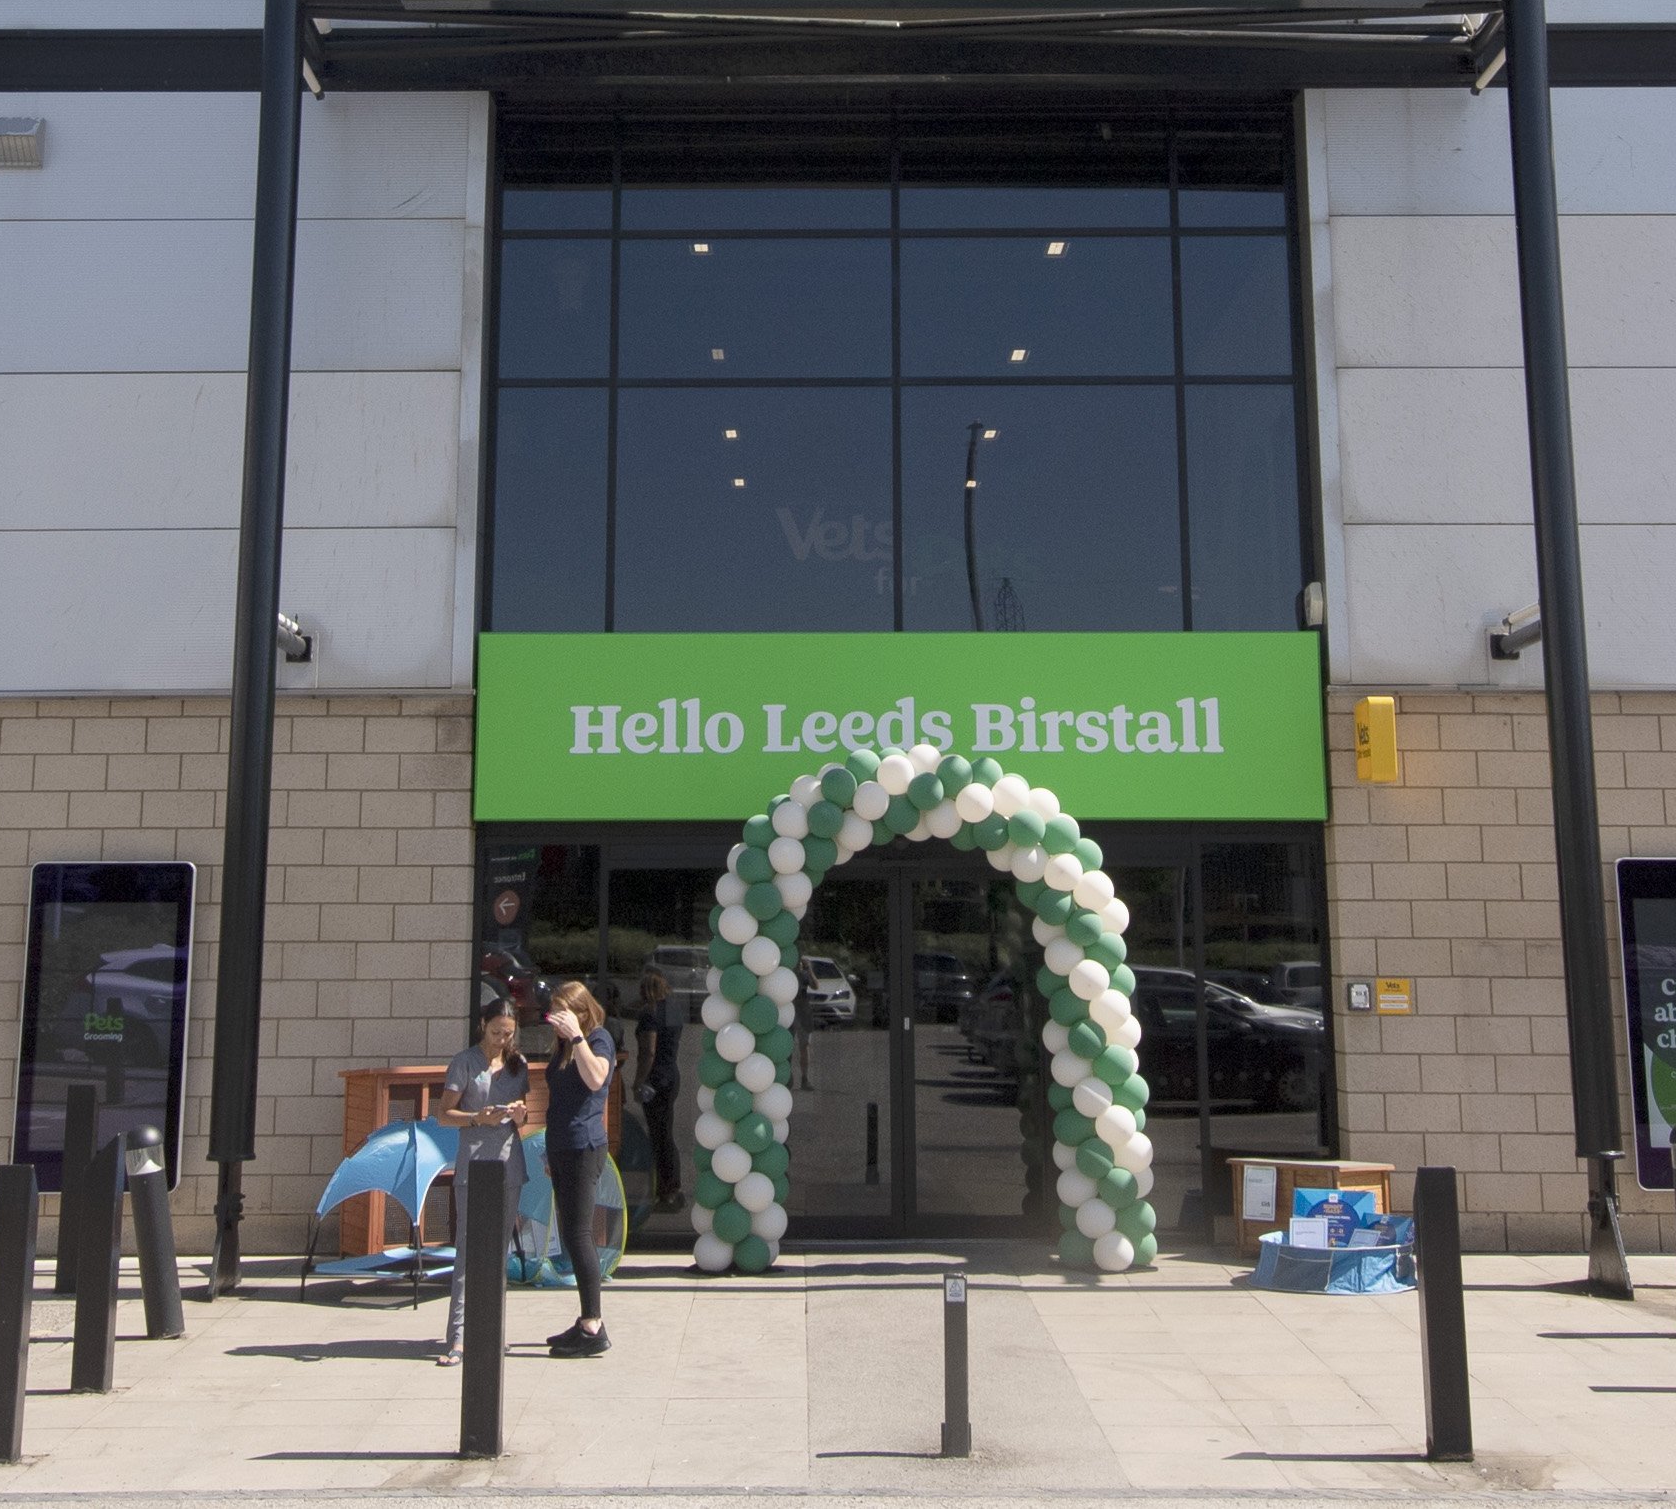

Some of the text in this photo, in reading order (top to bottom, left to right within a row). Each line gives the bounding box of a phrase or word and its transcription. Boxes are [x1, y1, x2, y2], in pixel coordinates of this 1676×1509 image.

[874, 567, 921, 595] fr
[569, 696, 1224, 754] Hello Leeds Birstall
[84, 1013, 124, 1031] Pets
[84, 1032, 123, 1042] Grooming
